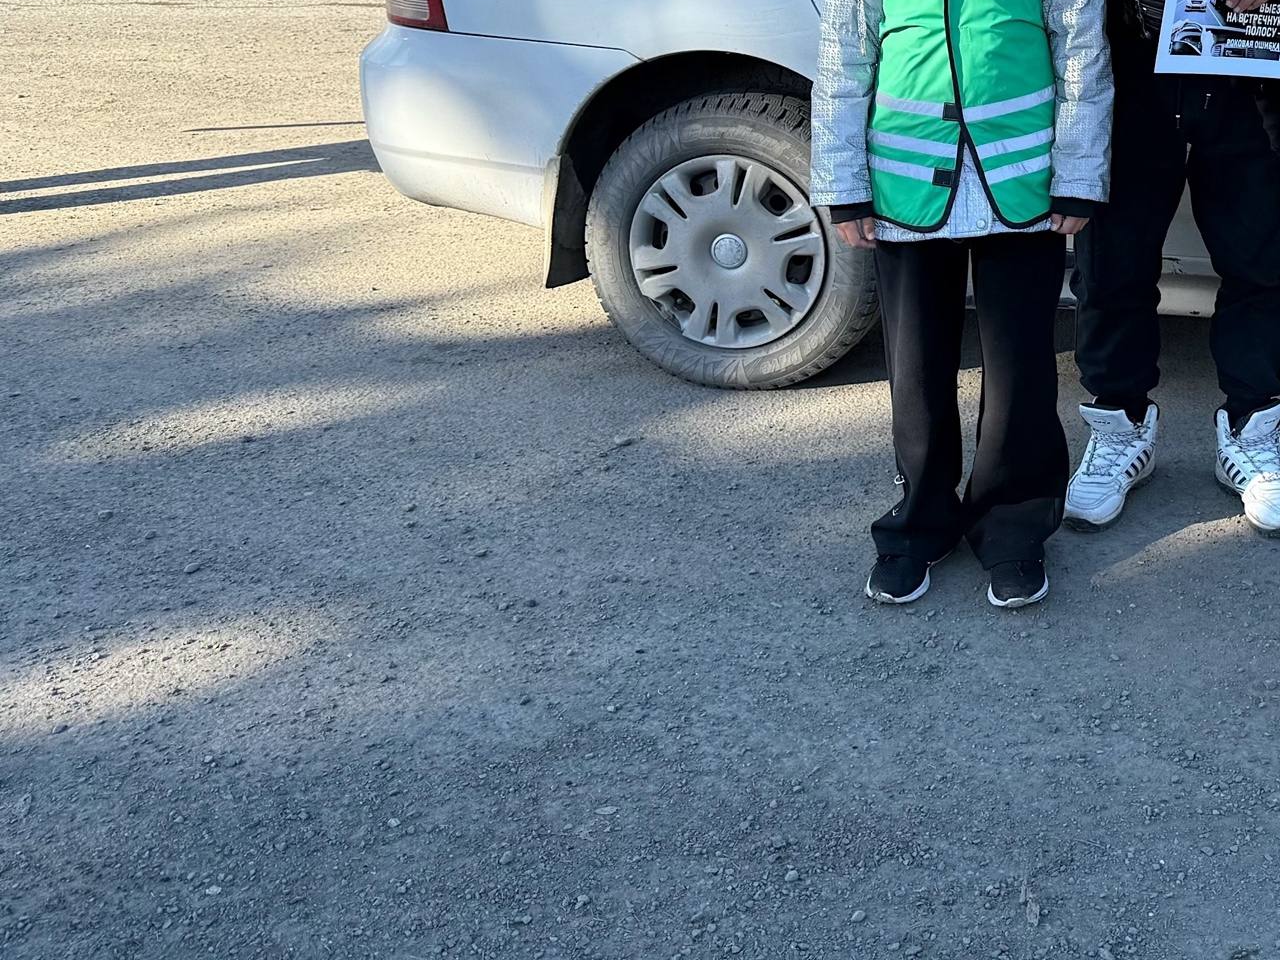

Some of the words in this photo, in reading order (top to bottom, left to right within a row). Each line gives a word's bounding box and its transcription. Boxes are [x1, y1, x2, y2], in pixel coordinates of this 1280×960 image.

[1226, 11, 1237, 23] НА
[1245, 25, 1277, 38] ПОЛОСУ
[1226, 38, 1254, 50] РОКОВАЯ
[1254, 40, 1280, 52] ОШИБКА
